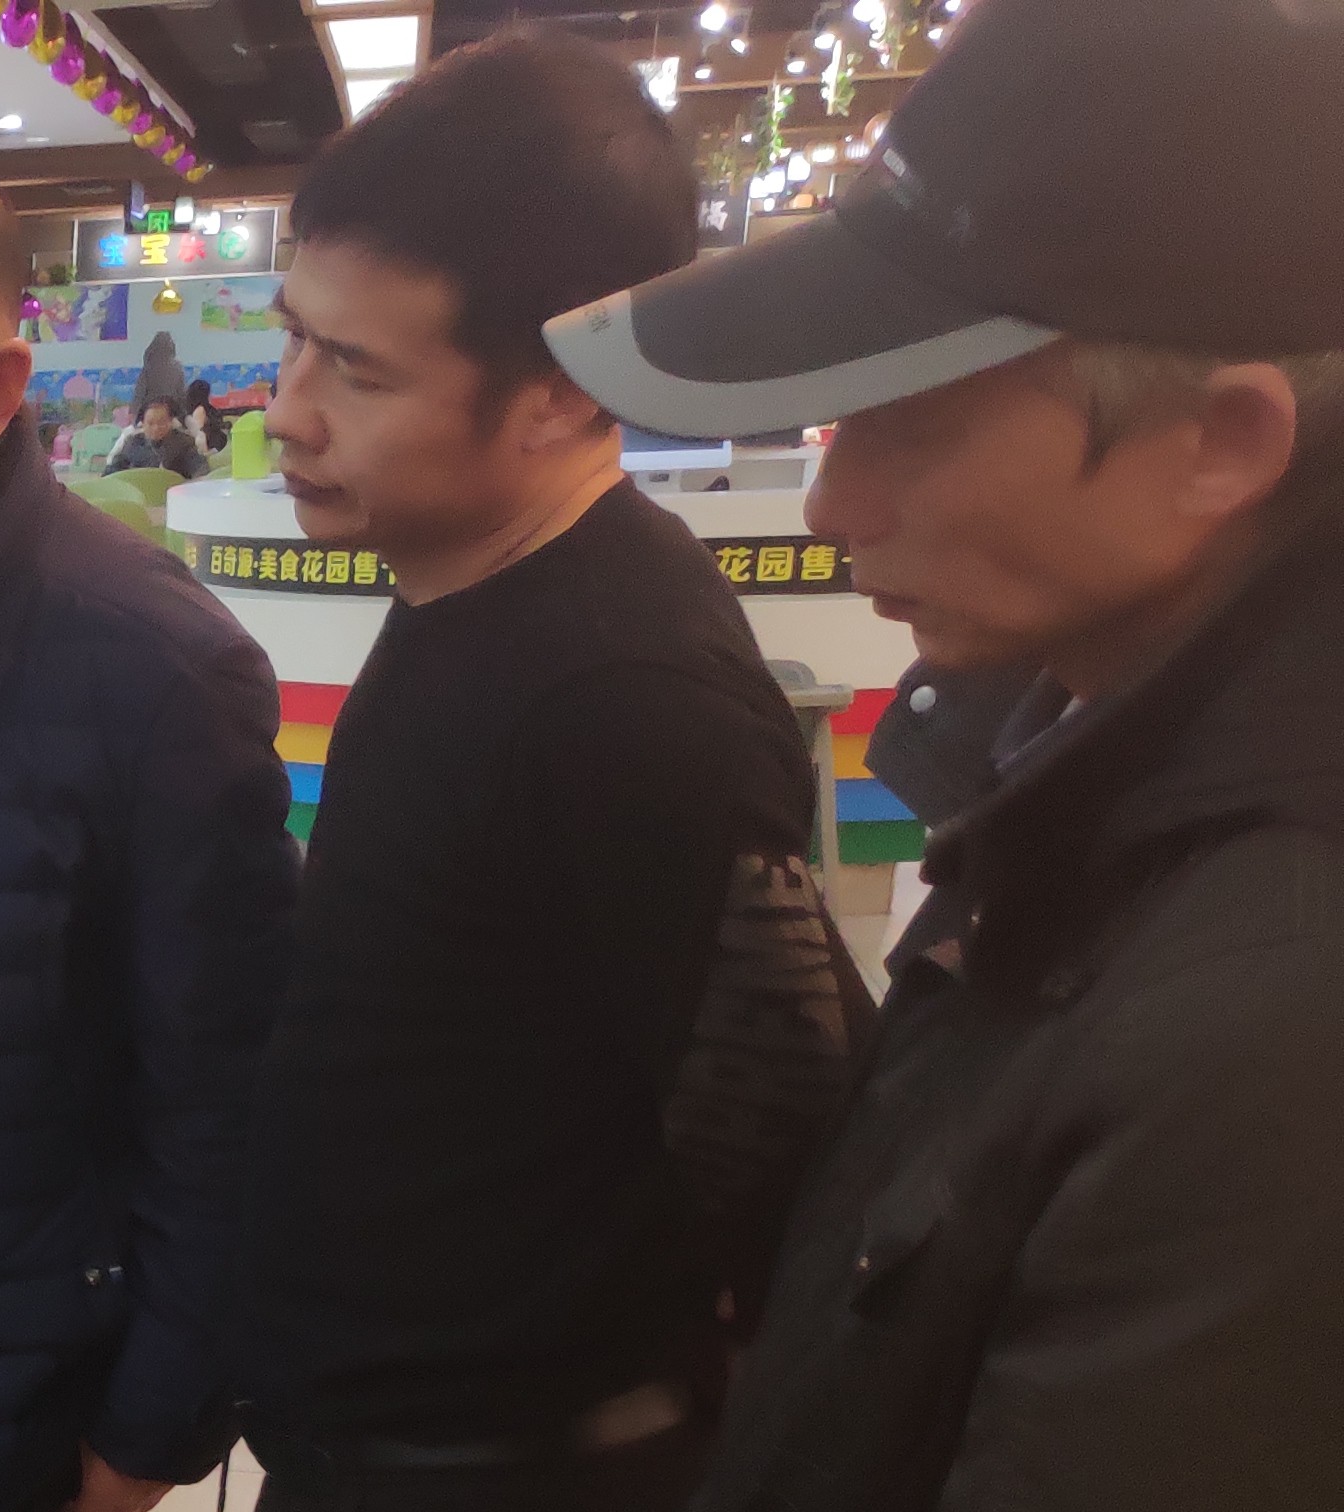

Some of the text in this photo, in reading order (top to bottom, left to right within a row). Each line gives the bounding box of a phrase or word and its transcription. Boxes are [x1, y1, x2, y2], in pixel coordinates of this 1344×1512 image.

[210, 544, 396, 586] 百奇源·美食花园售
[715, 544, 852, 583] 花园售
